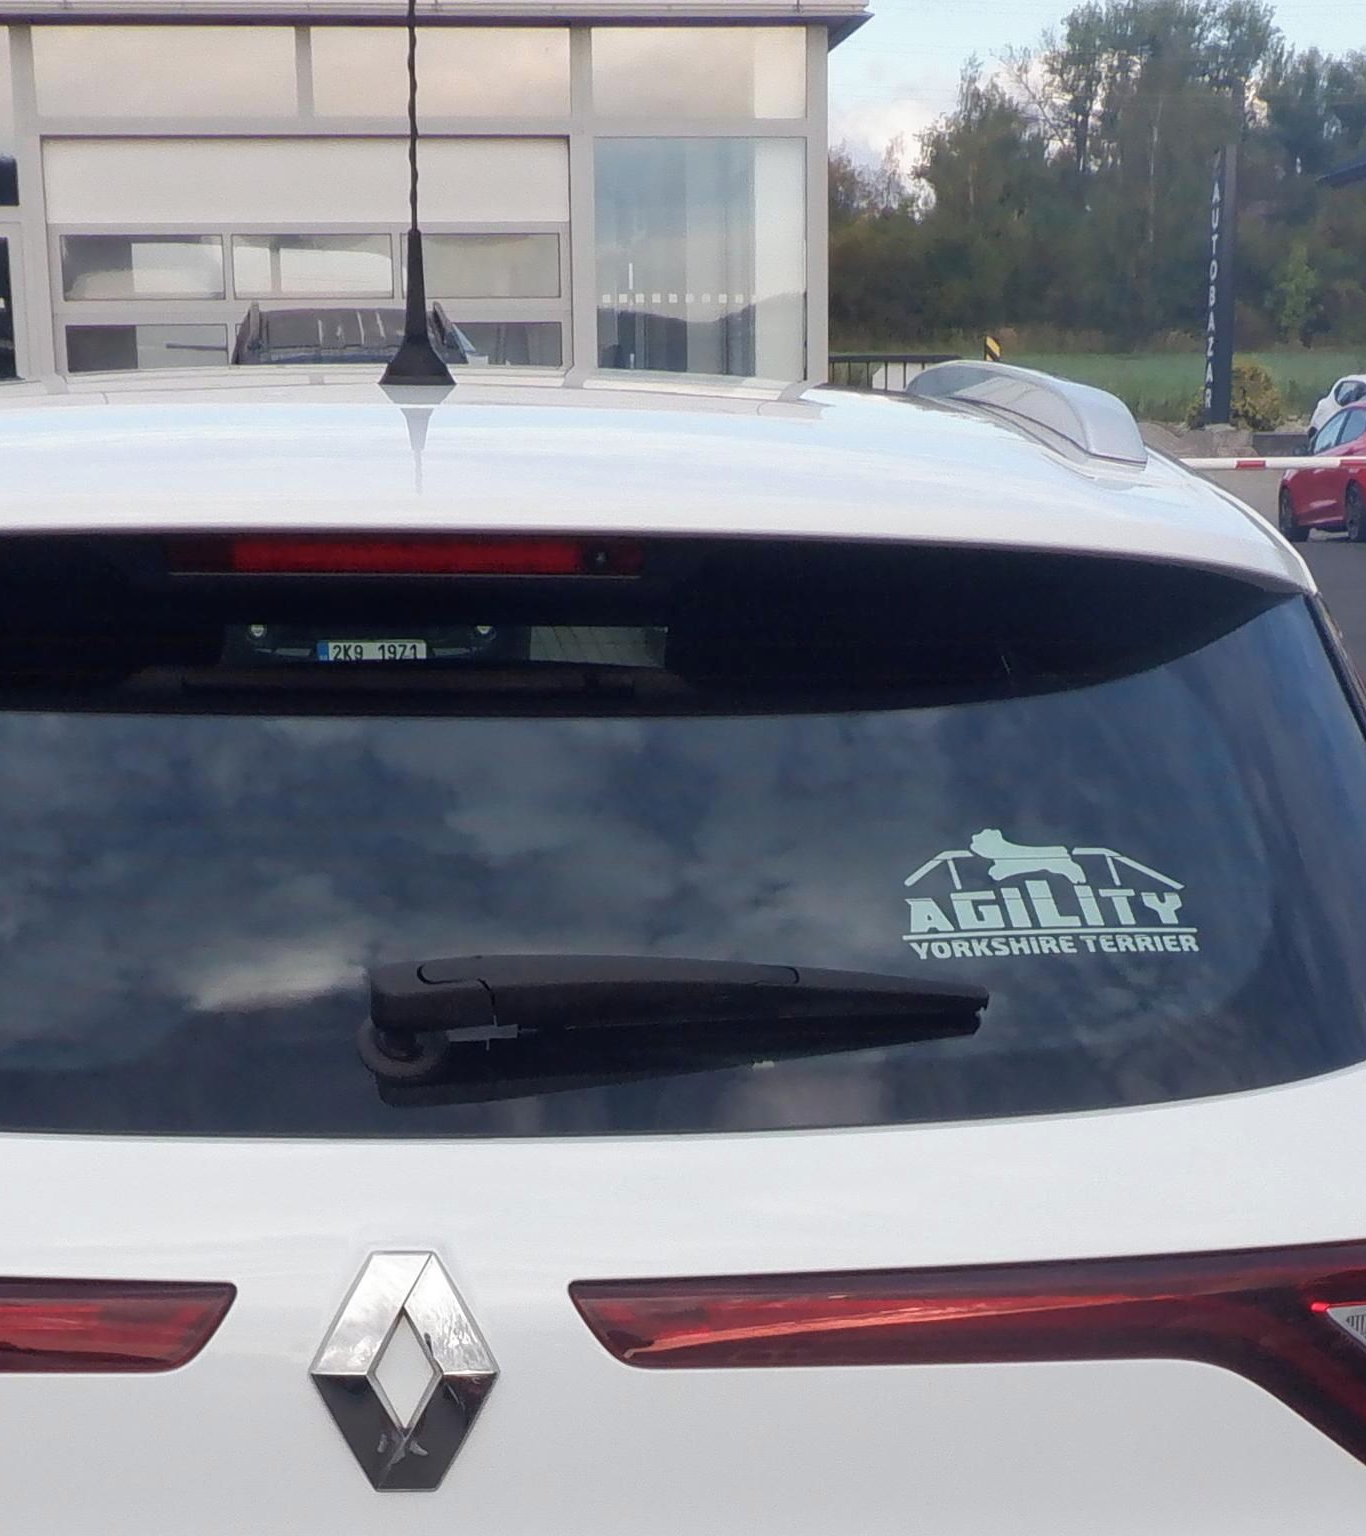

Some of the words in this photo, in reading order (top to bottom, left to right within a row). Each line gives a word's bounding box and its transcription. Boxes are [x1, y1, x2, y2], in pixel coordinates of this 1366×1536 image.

[1204, 181, 1221, 409] AUTOBAZAR
[332, 644, 364, 661] 2K9
[377, 643, 418, 660] 1971
[904, 880, 1186, 934] AGILITY
[909, 935, 1077, 961] YORKSHIRE
[1078, 934, 1200, 954] TERRIER
